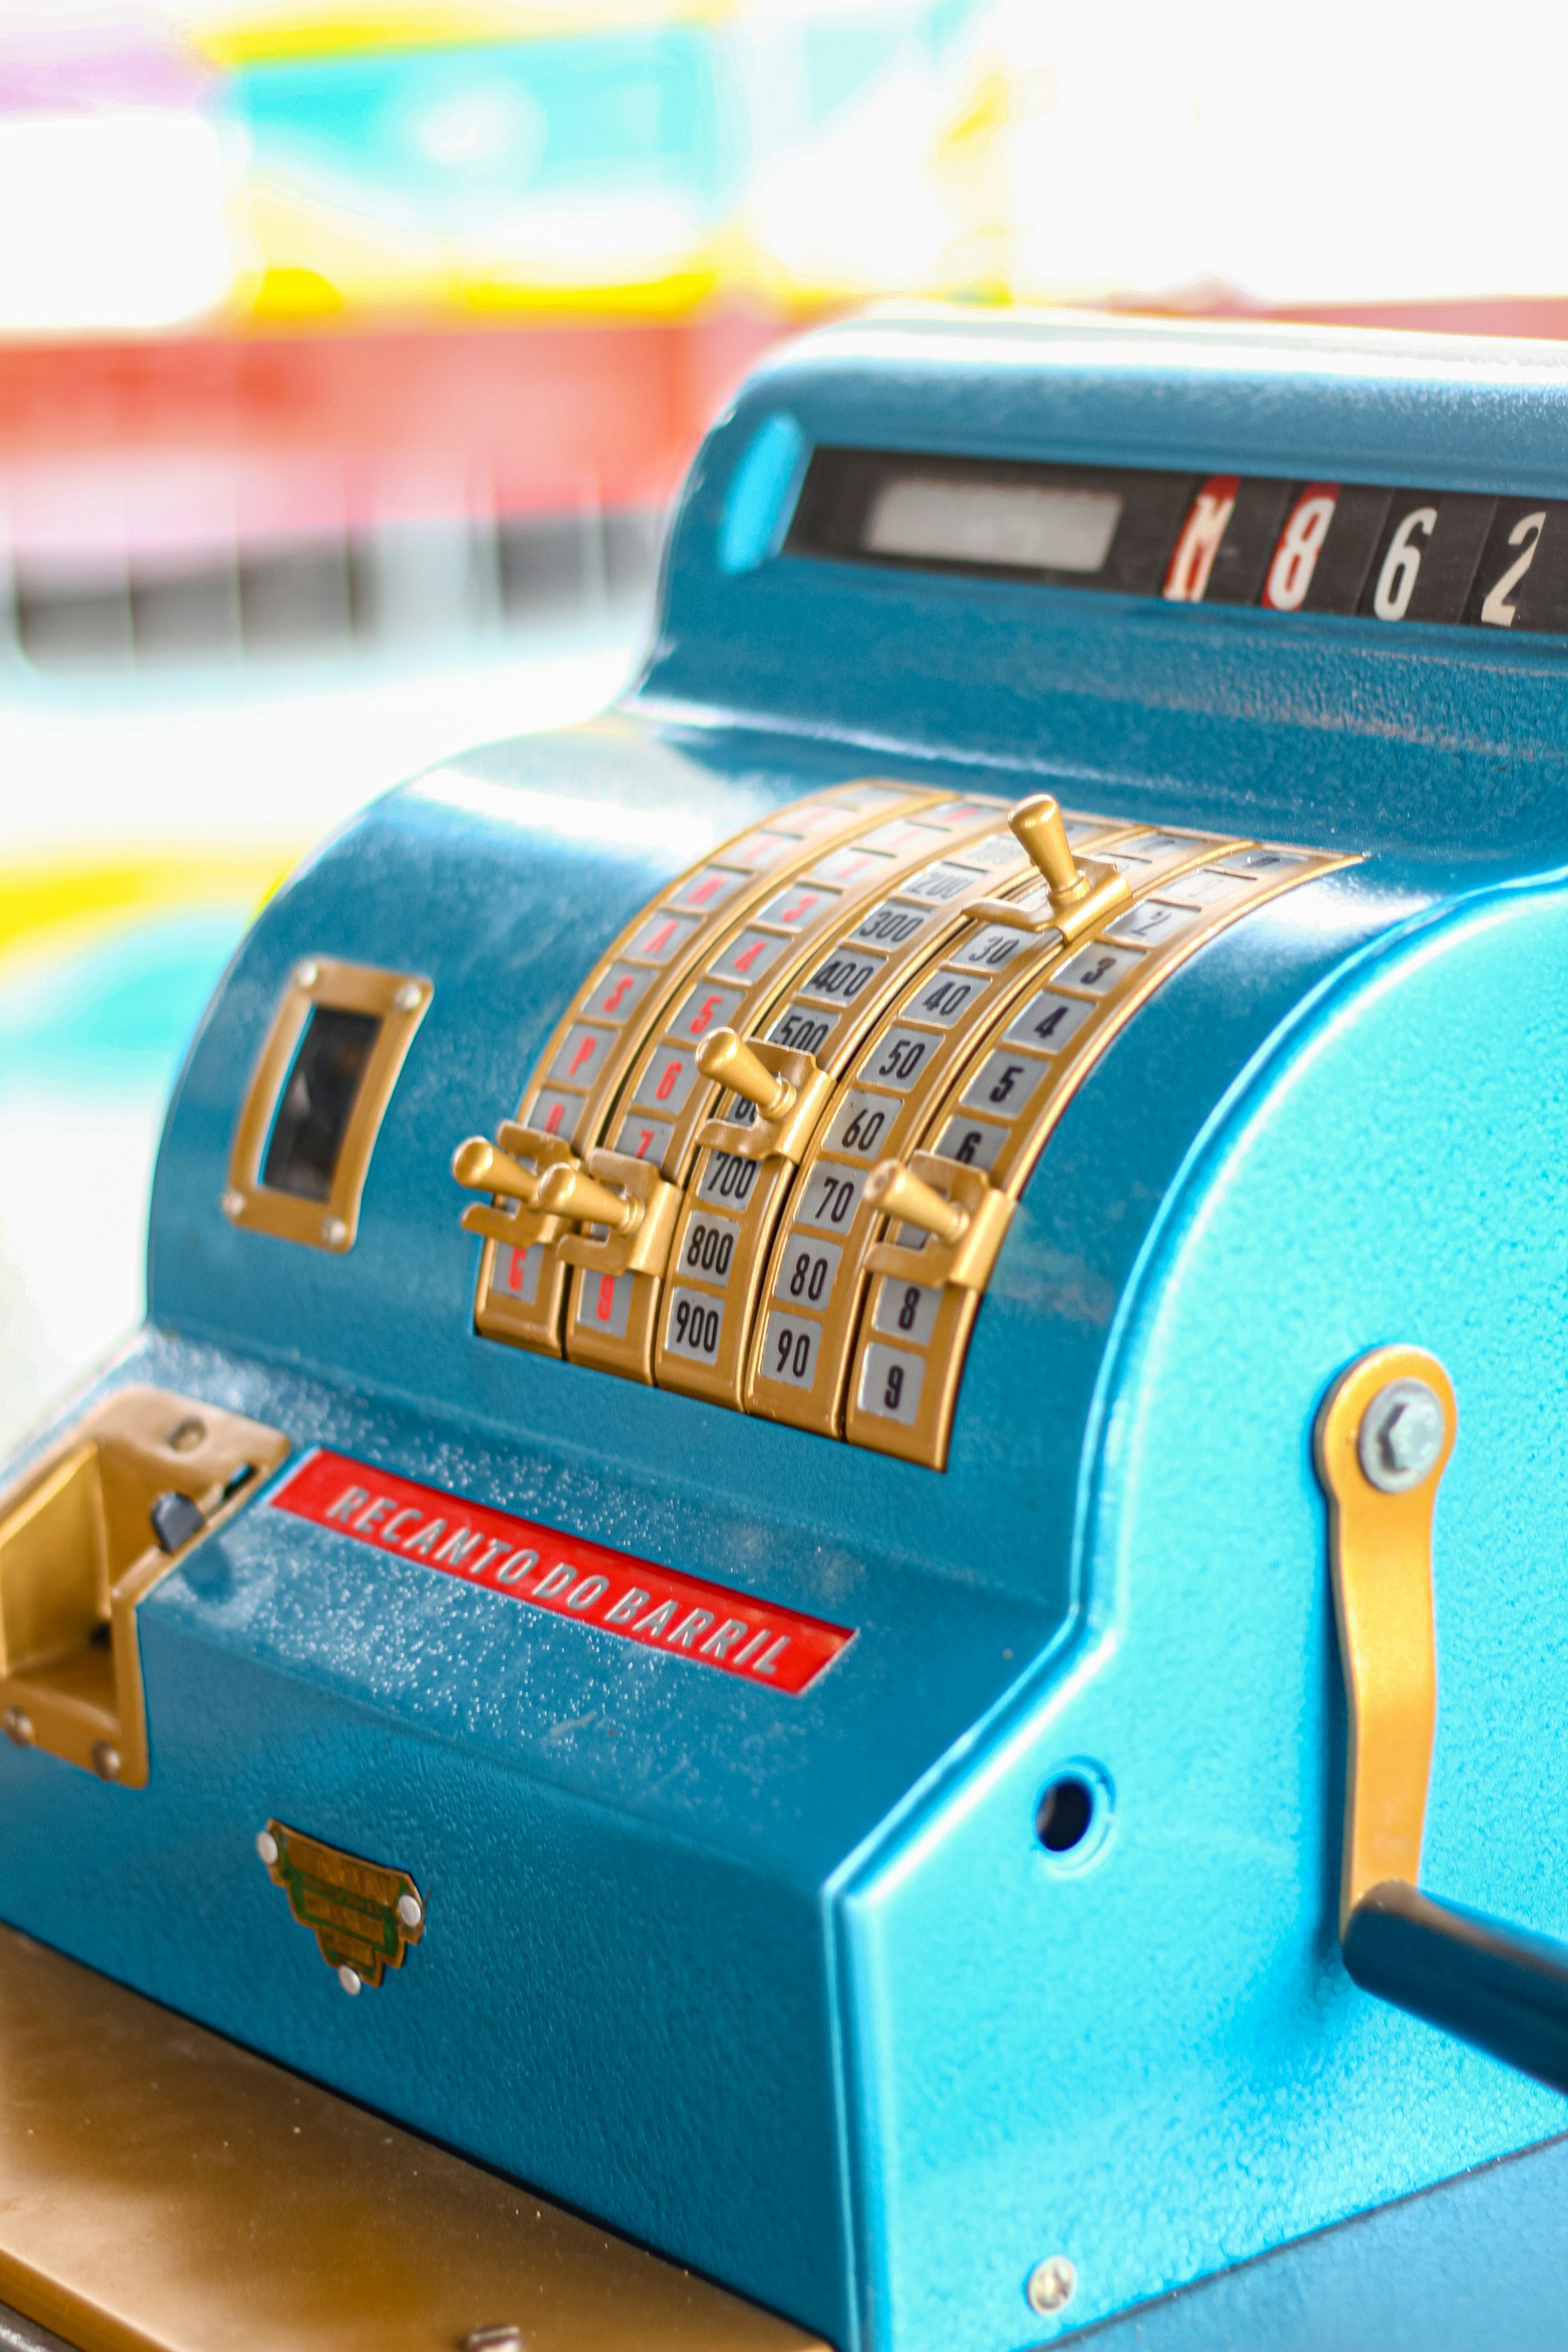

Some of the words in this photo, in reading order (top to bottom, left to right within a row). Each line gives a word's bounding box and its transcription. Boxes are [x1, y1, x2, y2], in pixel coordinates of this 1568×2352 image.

[1267, 497, 1337, 611] 8
[1373, 507, 1438, 622] 6
[1480, 511, 1547, 627] 2
[859, 909, 925, 943] 300
[733, 941, 767, 973] 4
[968, 935, 1020, 965] 30
[810, 959, 875, 996] 400
[1080, 956, 1117, 985] 3
[689, 995, 724, 1034] 5
[922, 981, 972, 1017] 40
[776, 1014, 829, 1053] 500
[1034, 1006, 1069, 1039] 4
[878, 1040, 926, 1080] 50
[655, 1060, 682, 1101] 6
[989, 1066, 1024, 1103] 5
[636, 1130, 654, 1159] 7
[842, 1109, 886, 1152] 60
[955, 1130, 983, 1164] 6
[706, 1152, 757, 1200] 700
[814, 1176, 856, 1223] 70
[686, 1225, 735, 1276] 800
[789, 1253, 828, 1301] 80
[676, 1300, 720, 1354] 900
[898, 1287, 921, 1331] 8
[776, 1329, 810, 1379] 90
[885, 1365, 905, 1410] 9
[326, 1485, 540, 1586] RECANTO
[532, 1561, 610, 1610] DO
[603, 1587, 793, 1675] BARRIL
